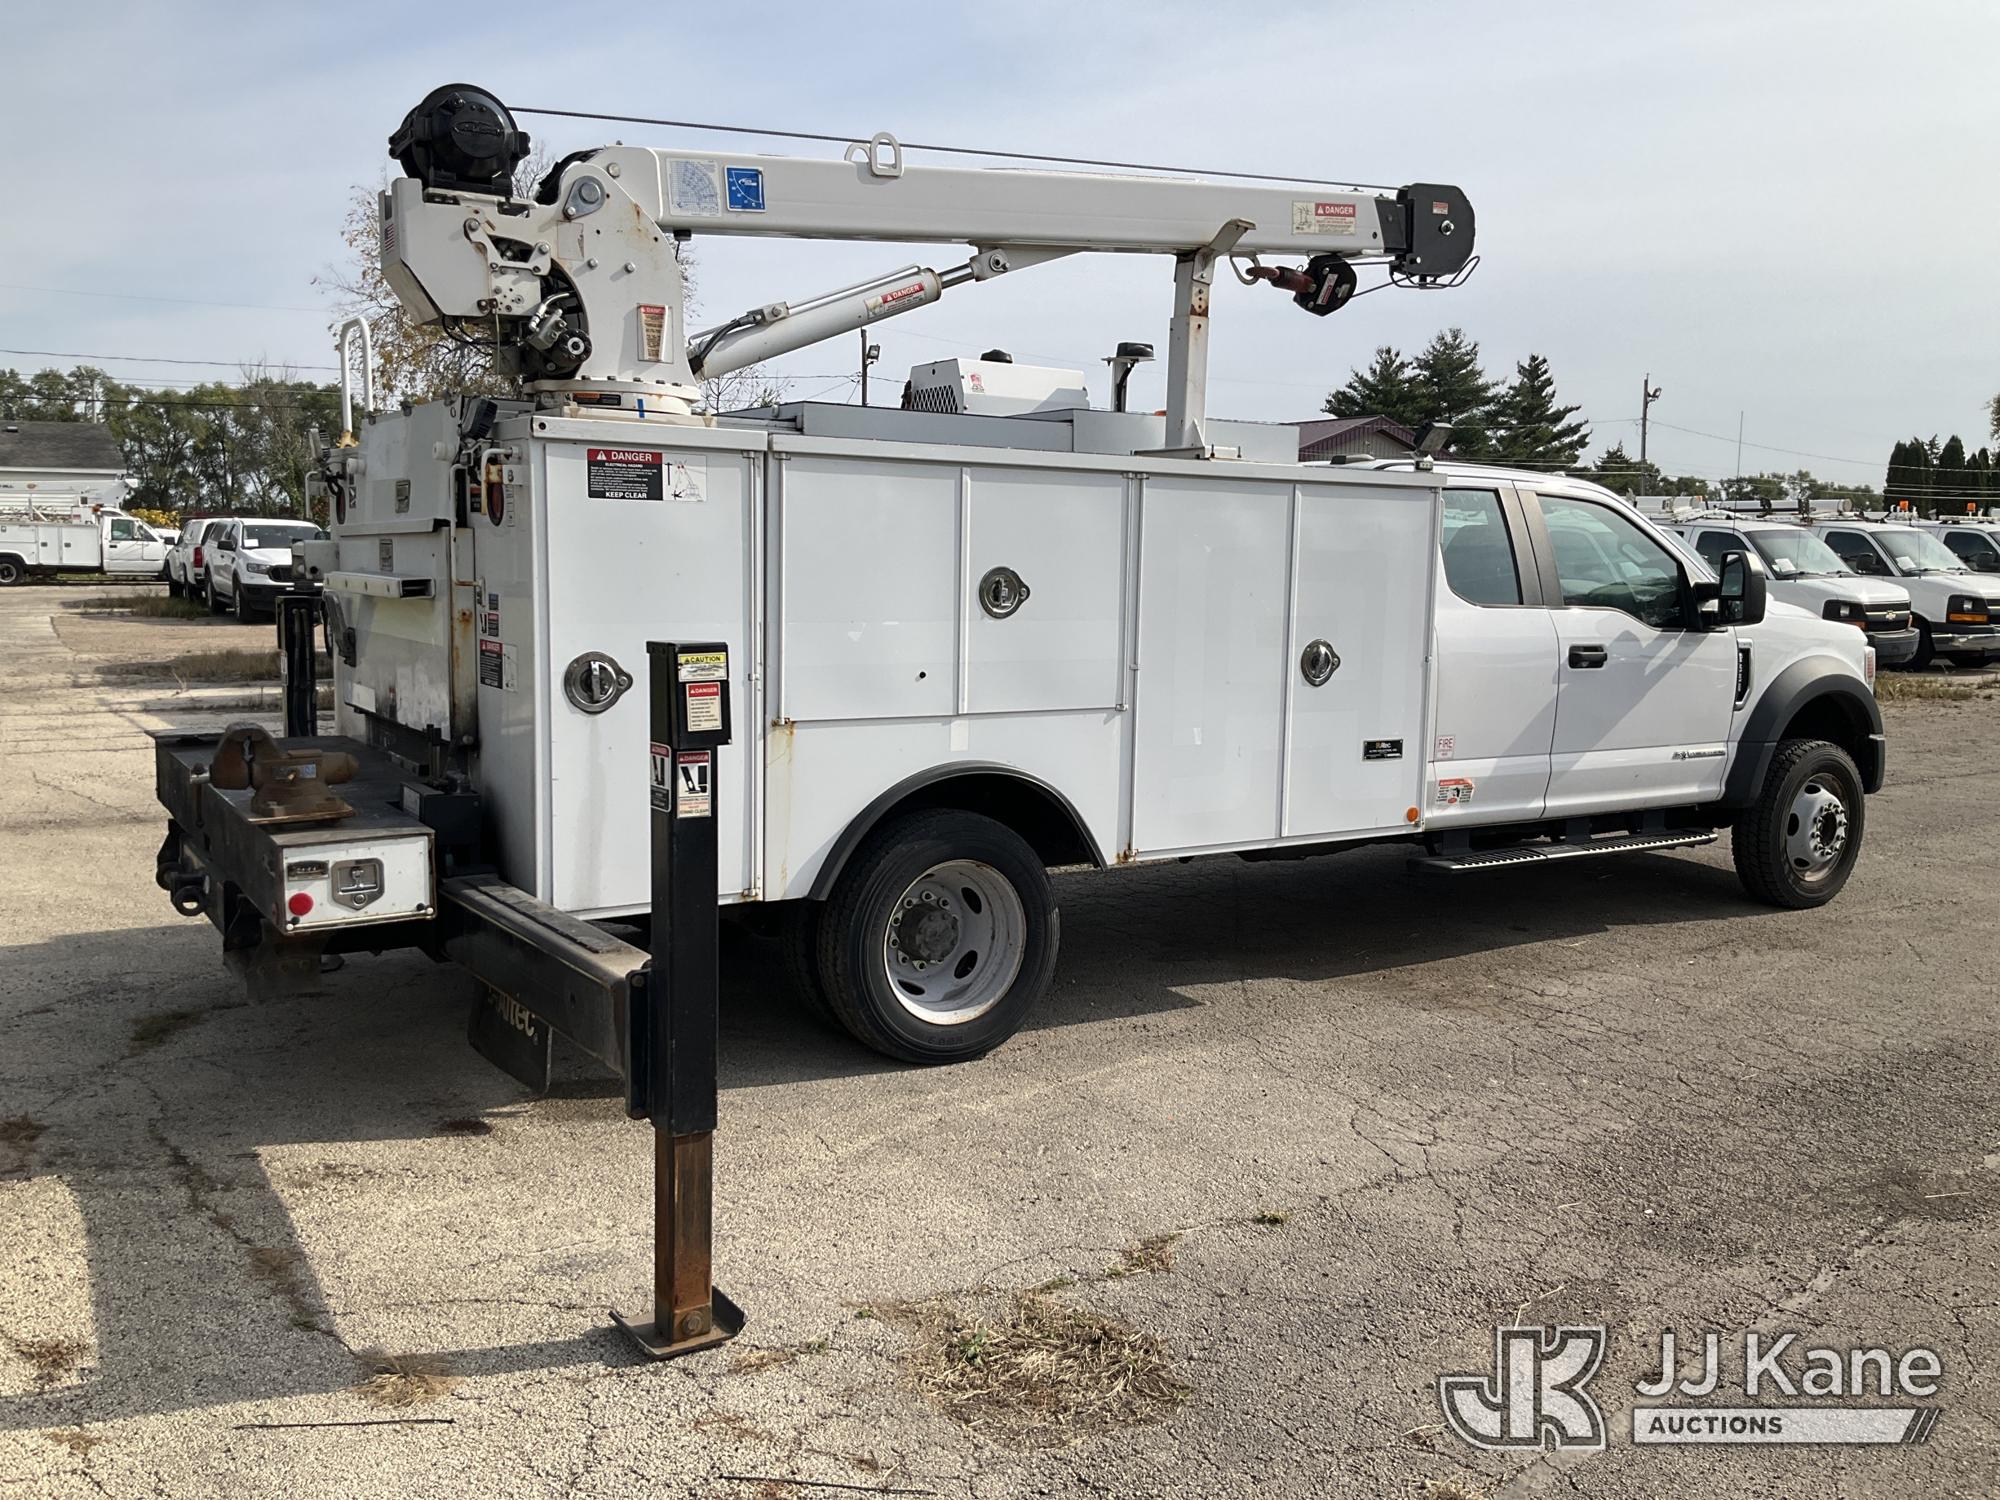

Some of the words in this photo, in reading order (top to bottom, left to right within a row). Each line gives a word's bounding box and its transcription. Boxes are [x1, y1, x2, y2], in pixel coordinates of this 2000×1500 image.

[1325, 206, 1354, 217] DANGER
[892, 284, 920, 299] DANGER
[611, 451, 652, 462] DANGER
[690, 655, 721, 663] CAUTION
[1439, 738, 1453, 749] FIRE
